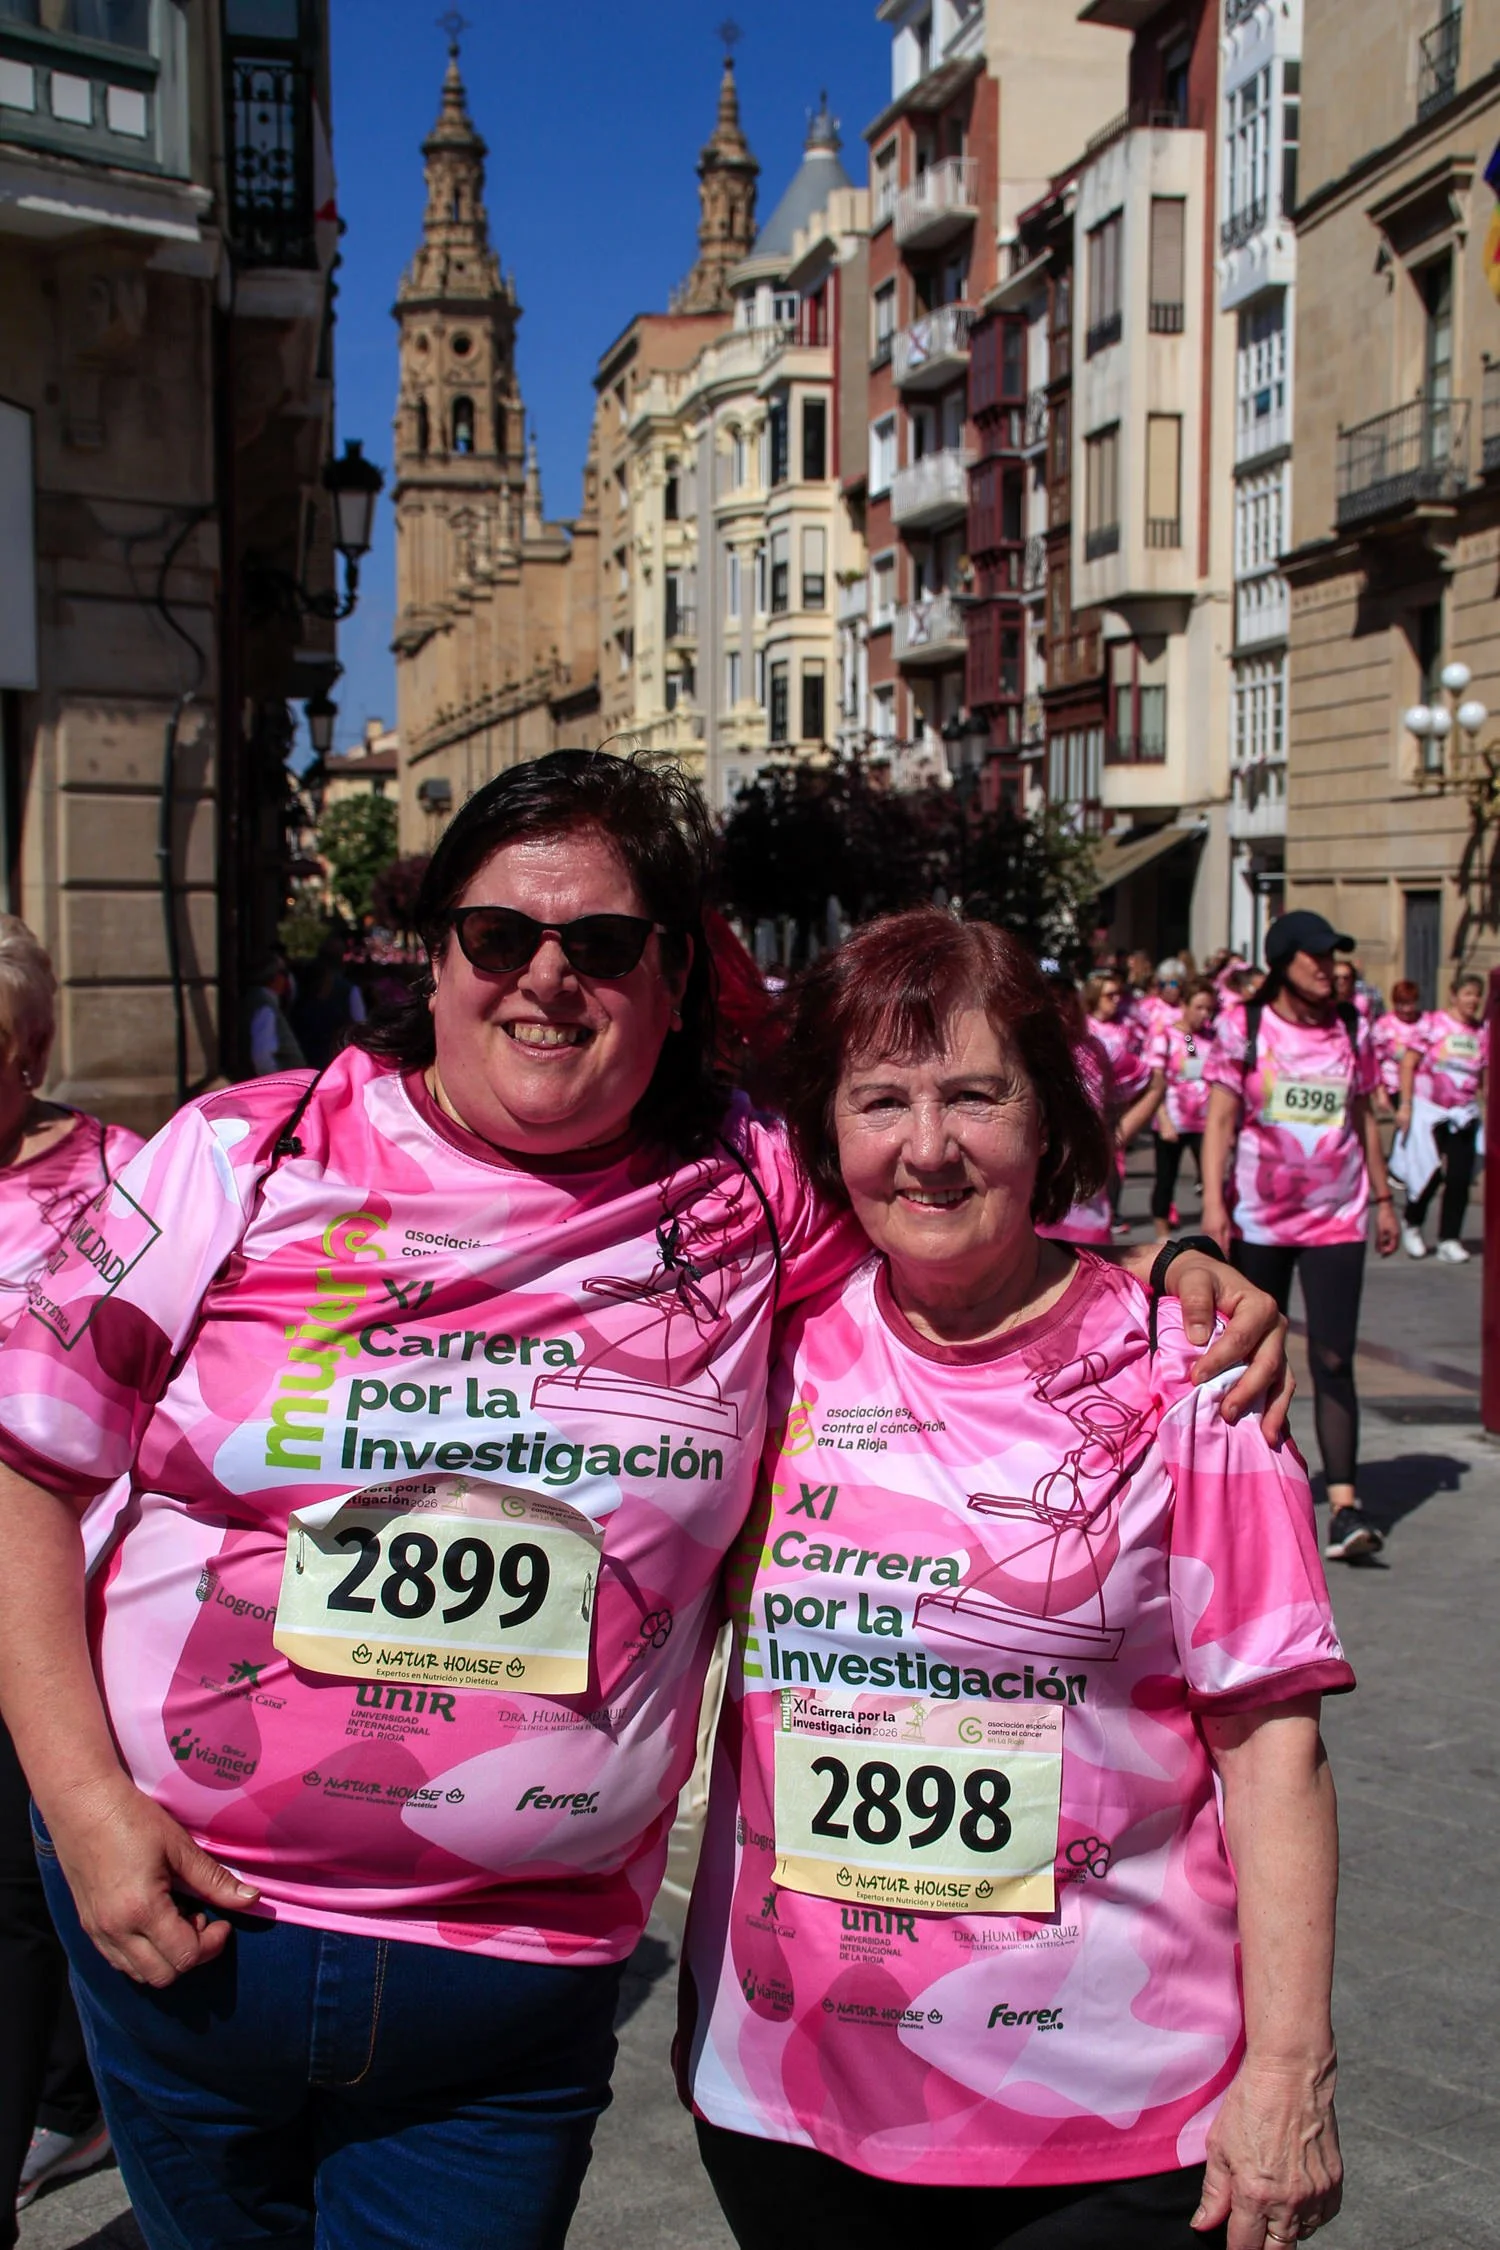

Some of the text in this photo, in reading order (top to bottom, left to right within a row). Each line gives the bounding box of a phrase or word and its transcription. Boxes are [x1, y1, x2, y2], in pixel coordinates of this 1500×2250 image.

[1285, 1087, 1336, 1113] 6398
[378, 1278, 436, 1311] XI
[358, 1322, 577, 1367] Carrera
[265, 1267, 367, 1471] mujer
[345, 1376, 521, 1421] por la
[826, 1405, 893, 1419] asociación
[821, 1422, 862, 1434] contra
[866, 1421, 878, 1434] el
[817, 1437, 888, 1453] en La Rioja
[340, 1426, 723, 1486] Investigación
[396, 1484, 420, 1493] por
[423, 1484, 436, 1494] la
[346, 1494, 438, 1509] tigación 2026
[787, 1483, 838, 1521] XI
[772, 1531, 961, 1588] Carrera
[326, 1526, 551, 1630] 2899
[216, 1587, 277, 1625] Logroñ
[764, 1592, 903, 1638] por la
[376, 1649, 503, 1674] NATUR HOUSE
[376, 1669, 410, 1679] Expertos
[423, 1673, 458, 1683] Nutrición
[465, 1677, 499, 1686] Dietética
[769, 1639, 1087, 1706] Investigación
[351, 1710, 419, 1725] UNIVERSIDAD
[779, 1689, 792, 1729] mujer
[793, 1698, 897, 1723] XI Carrera por la
[345, 1727, 405, 1742] DE LA RIOJA
[348, 1718, 431, 1736] INTERNACIONAL
[792, 1716, 898, 1738] investigación 2026
[987, 1721, 1057, 1731] asociación española
[987, 1729, 1010, 1737] contra
[1019, 1730, 1042, 1738] cáncer
[195, 1745, 258, 1775] viamed
[324, 1777, 444, 1802] NATUR HOUSE
[405, 1801, 438, 1809] Dietética
[570, 1807, 591, 1816] sport
[810, 1756, 1012, 1853] 2898
[855, 1872, 972, 1898] NATUR HOUSE
[856, 1891, 885, 1902] Expertos
[886, 1895, 895, 1903] en
[896, 1895, 929, 1906] Nutrición
[936, 1899, 969, 1908] Dietética
[840, 1935, 891, 1946] UNIVERSIDAD
[952, 1925, 1080, 1944] DRA. HUMILDAD RUIZ
[839, 1944, 903, 1957] INTERNACIONAL
[839, 1953, 885, 1964] DE LA RIOJA
[880, 2008, 925, 2022] HOUSE
[1037, 2022, 1057, 2032] sport
